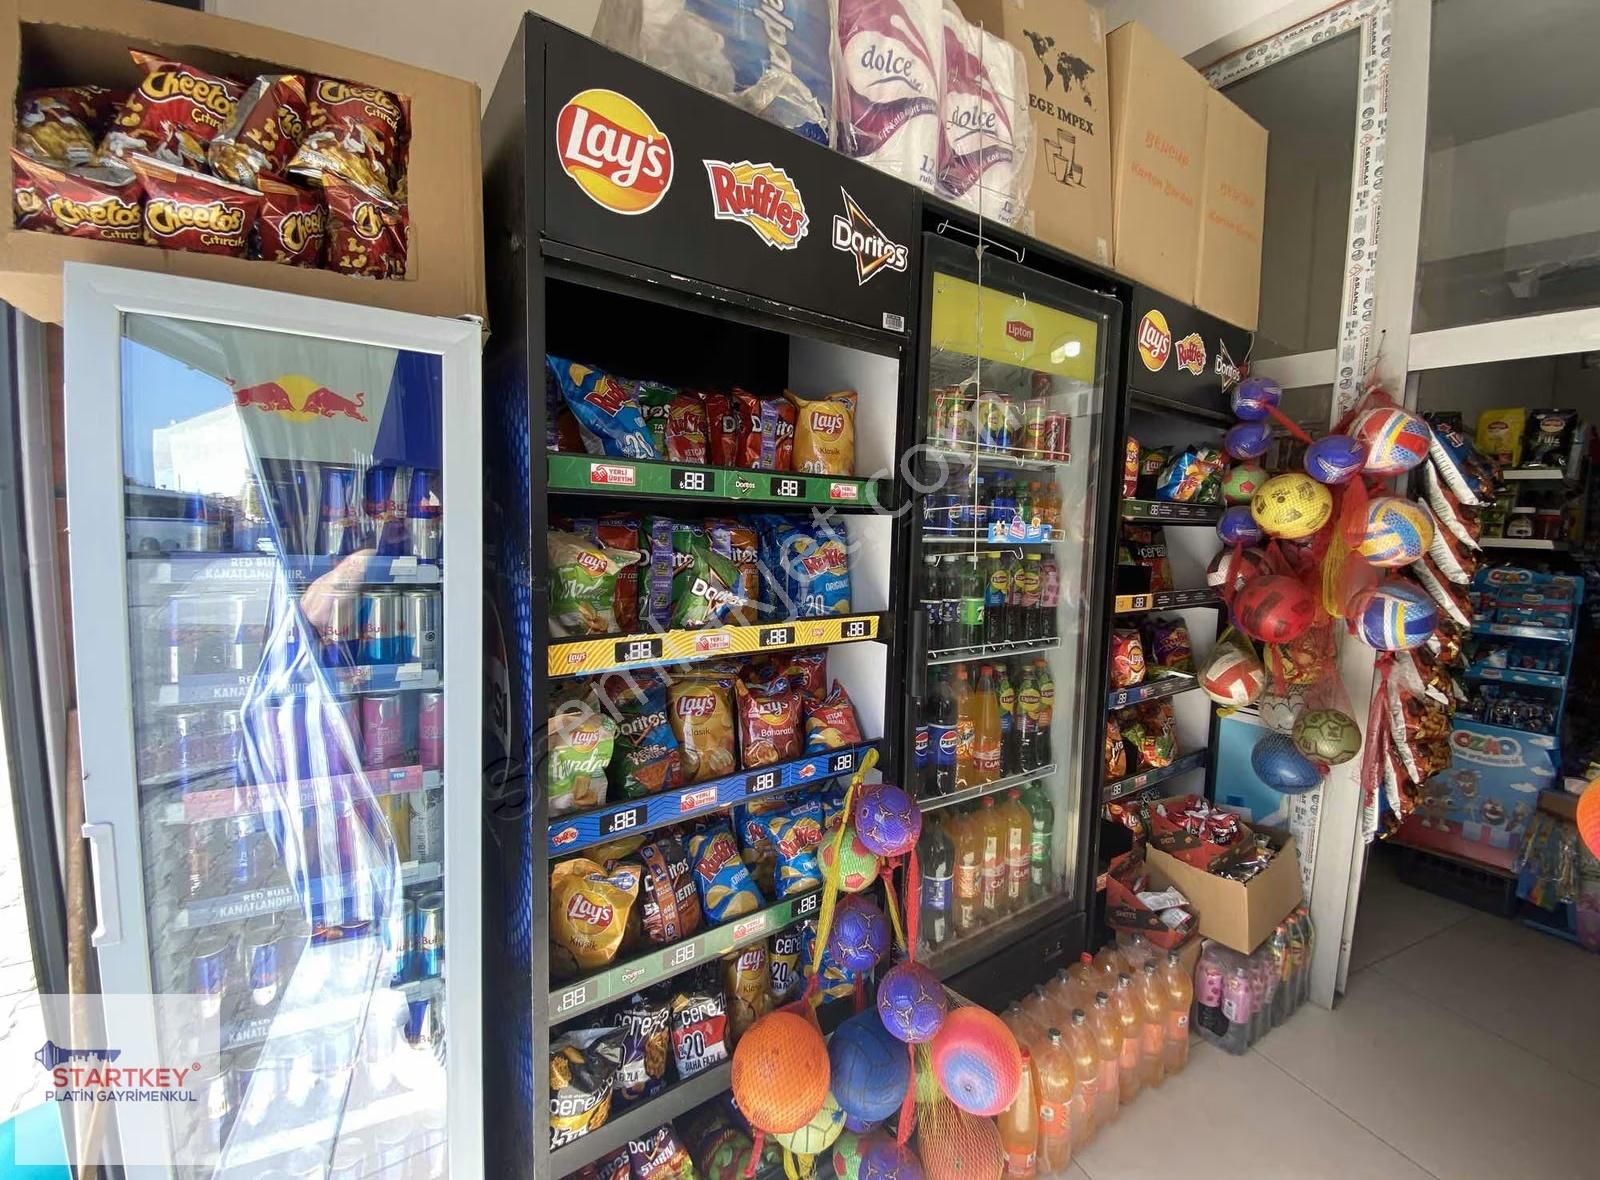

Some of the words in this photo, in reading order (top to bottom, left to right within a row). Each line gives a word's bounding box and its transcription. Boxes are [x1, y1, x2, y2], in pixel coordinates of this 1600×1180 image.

[861, 45, 912, 76] dolce
[953, 105, 996, 128] dolce
[1029, 93, 1055, 116] EGE
[1057, 106, 1094, 136] IMPEX
[565, 107, 666, 188] Lay's
[710, 165, 804, 240] Ruffles
[146, 200, 243, 234] Cheetos
[834, 216, 908, 270] Doritos
[1008, 323, 1032, 339] Lipton
[1139, 318, 1170, 358] Lay's
[1215, 356, 1241, 382] Doritos
[813, 412, 843, 434] Lay's
[735, 480, 756, 490] Doritos
[580, 552, 608, 571] Lay's
[692, 578, 747, 606] Doritos
[679, 695, 714, 717] Lay's
[573, 731, 600, 745] Lay's
[568, 893, 612, 924] Lay's
